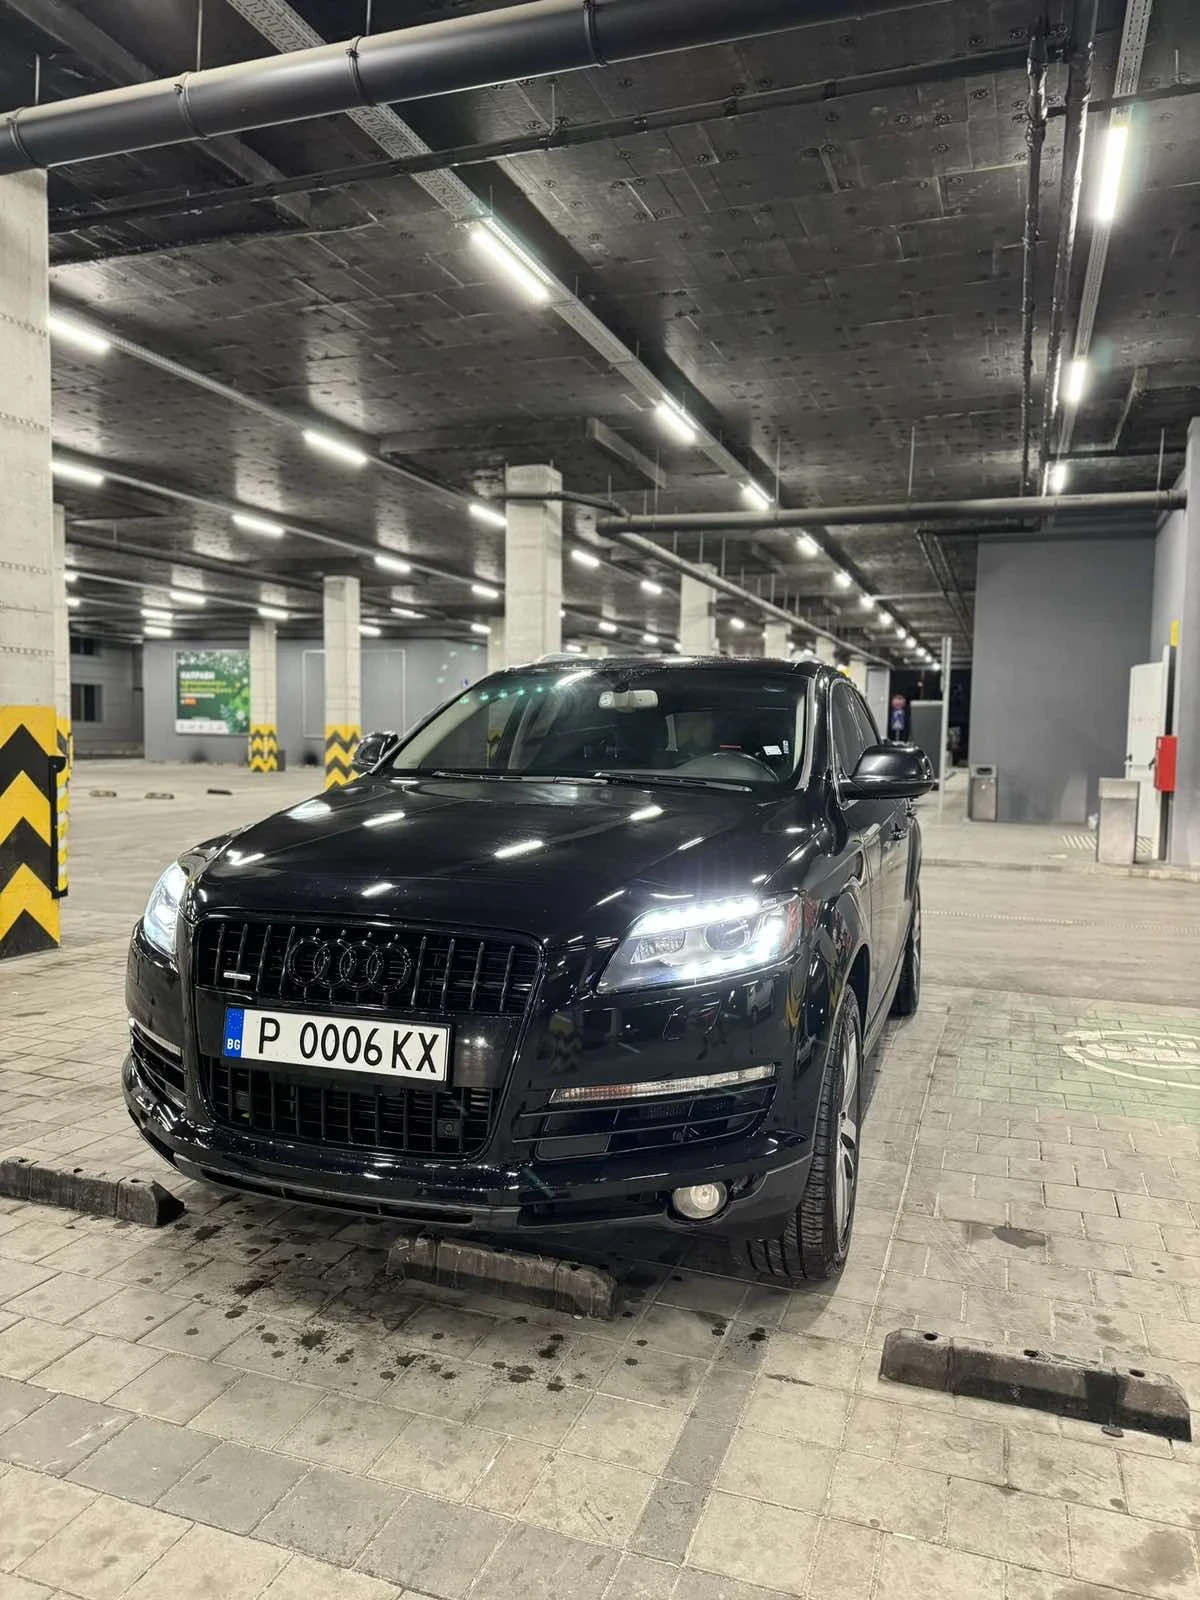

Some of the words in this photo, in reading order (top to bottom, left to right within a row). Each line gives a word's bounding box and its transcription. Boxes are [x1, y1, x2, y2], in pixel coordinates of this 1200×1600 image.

[227, 1038, 241, 1051] BG
[258, 1017, 280, 1054] P
[299, 1022, 383, 1066] 0006
[391, 1030, 439, 1073] KX
